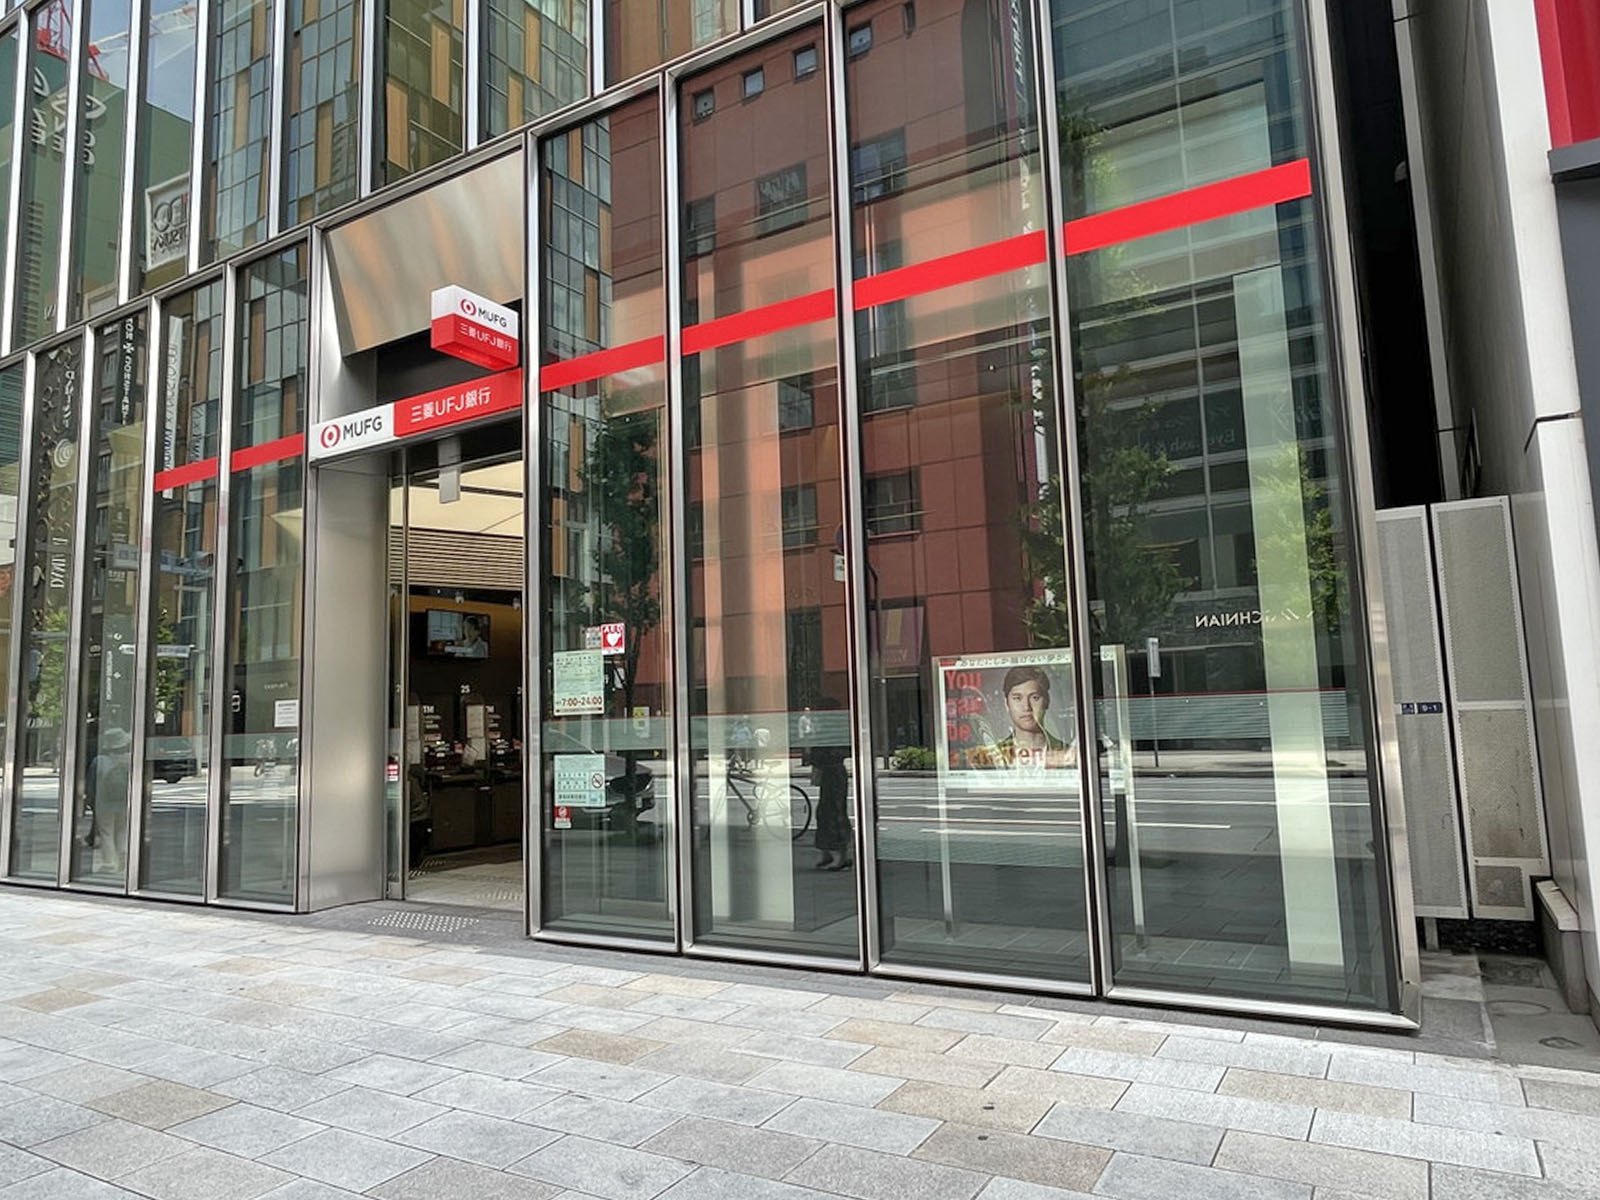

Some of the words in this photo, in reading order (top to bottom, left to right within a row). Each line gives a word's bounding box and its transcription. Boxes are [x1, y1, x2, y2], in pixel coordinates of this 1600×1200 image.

[478, 307, 508, 328] MUFG
[459, 323, 512, 352] 三菱UFJ銀行
[410, 386, 492, 423] 三菱UFJ銀行
[342, 416, 383, 440] MUFG
[945, 671, 981, 689] You
